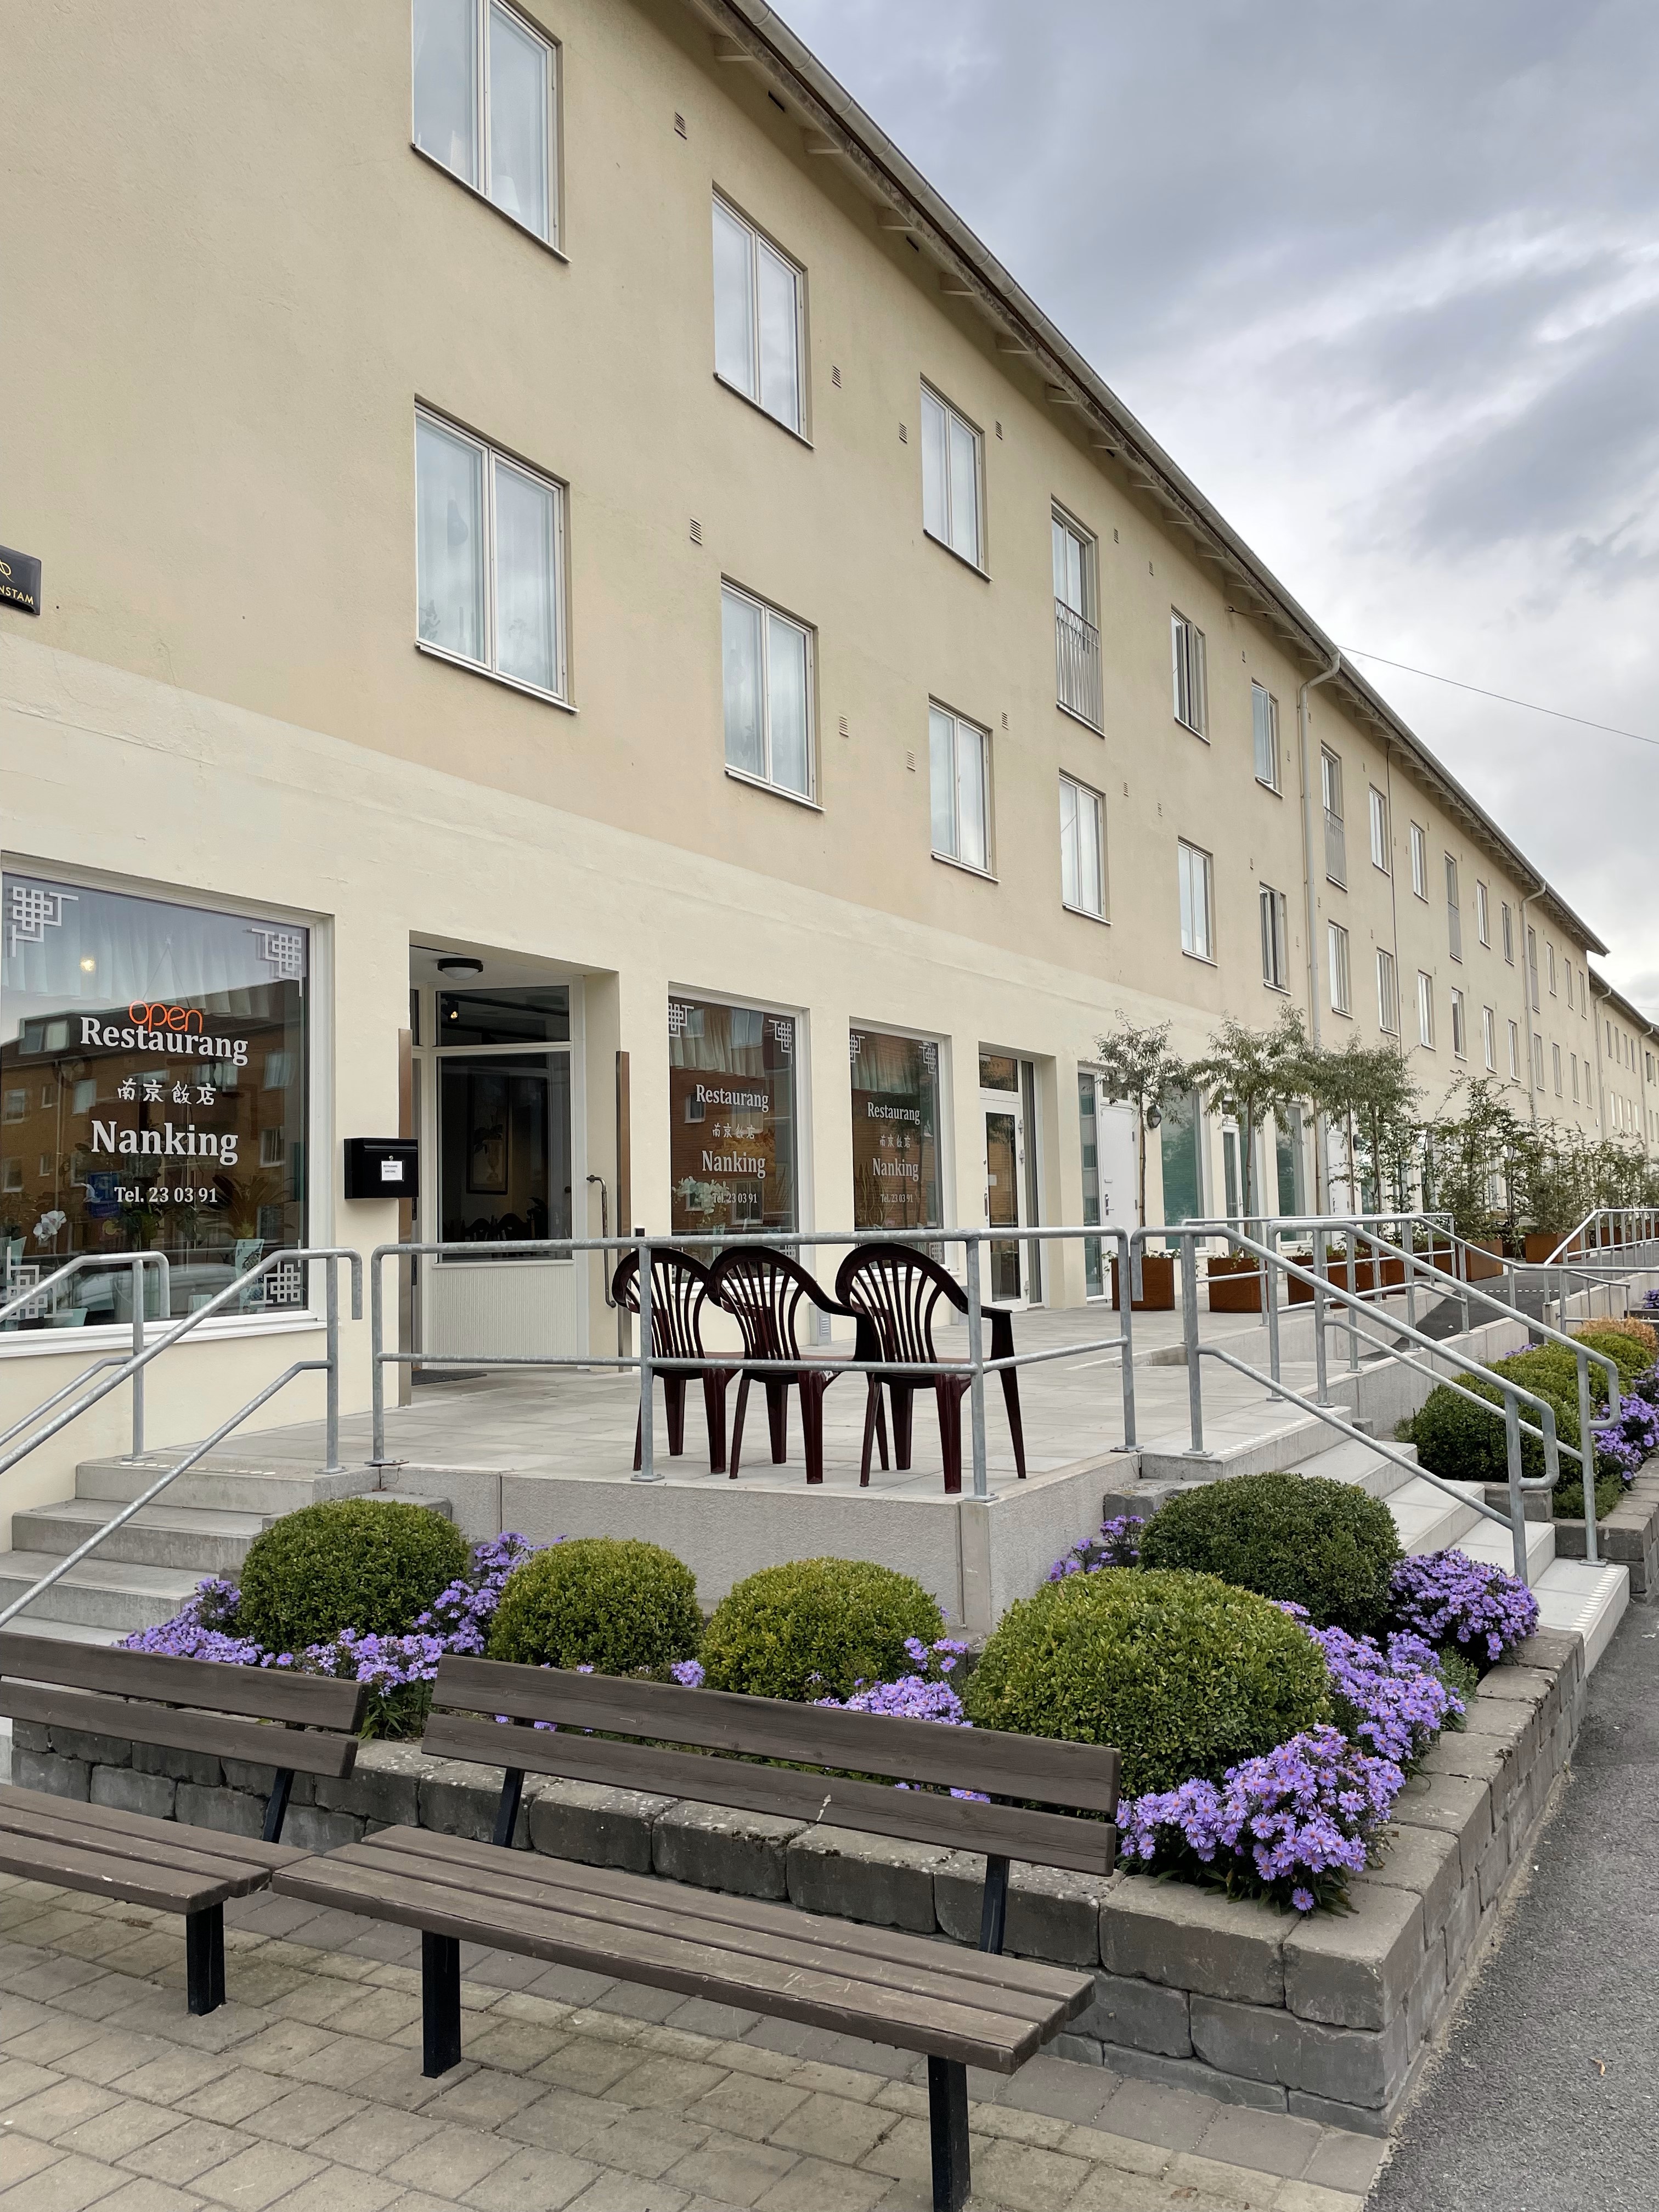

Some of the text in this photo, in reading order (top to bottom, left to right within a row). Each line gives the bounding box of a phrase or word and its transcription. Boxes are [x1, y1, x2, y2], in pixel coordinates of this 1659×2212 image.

[129, 1000, 203, 1034] open
[80, 1017, 249, 1066] Restaurang
[117, 1077, 217, 1105] 南京飯店
[696, 1084, 769, 1113] Restaurang
[867, 1102, 921, 1125] Restaurang
[91, 1120, 238, 1166] Nanking
[712, 1122, 755, 1139] 南京飯店
[702, 1150, 766, 1179] Nanking
[872, 1158, 919, 1182] Nanking
[114, 1187, 218, 1203] Tel. 23 03 91
[727, 1193, 736, 1204] 23
[737, 1193, 747, 1204] 03
[748, 1193, 758, 1204] 91
[891, 1194, 898, 1203] 23
[899, 1194, 906, 1203] 03
[906, 1194, 913, 1203] 91
